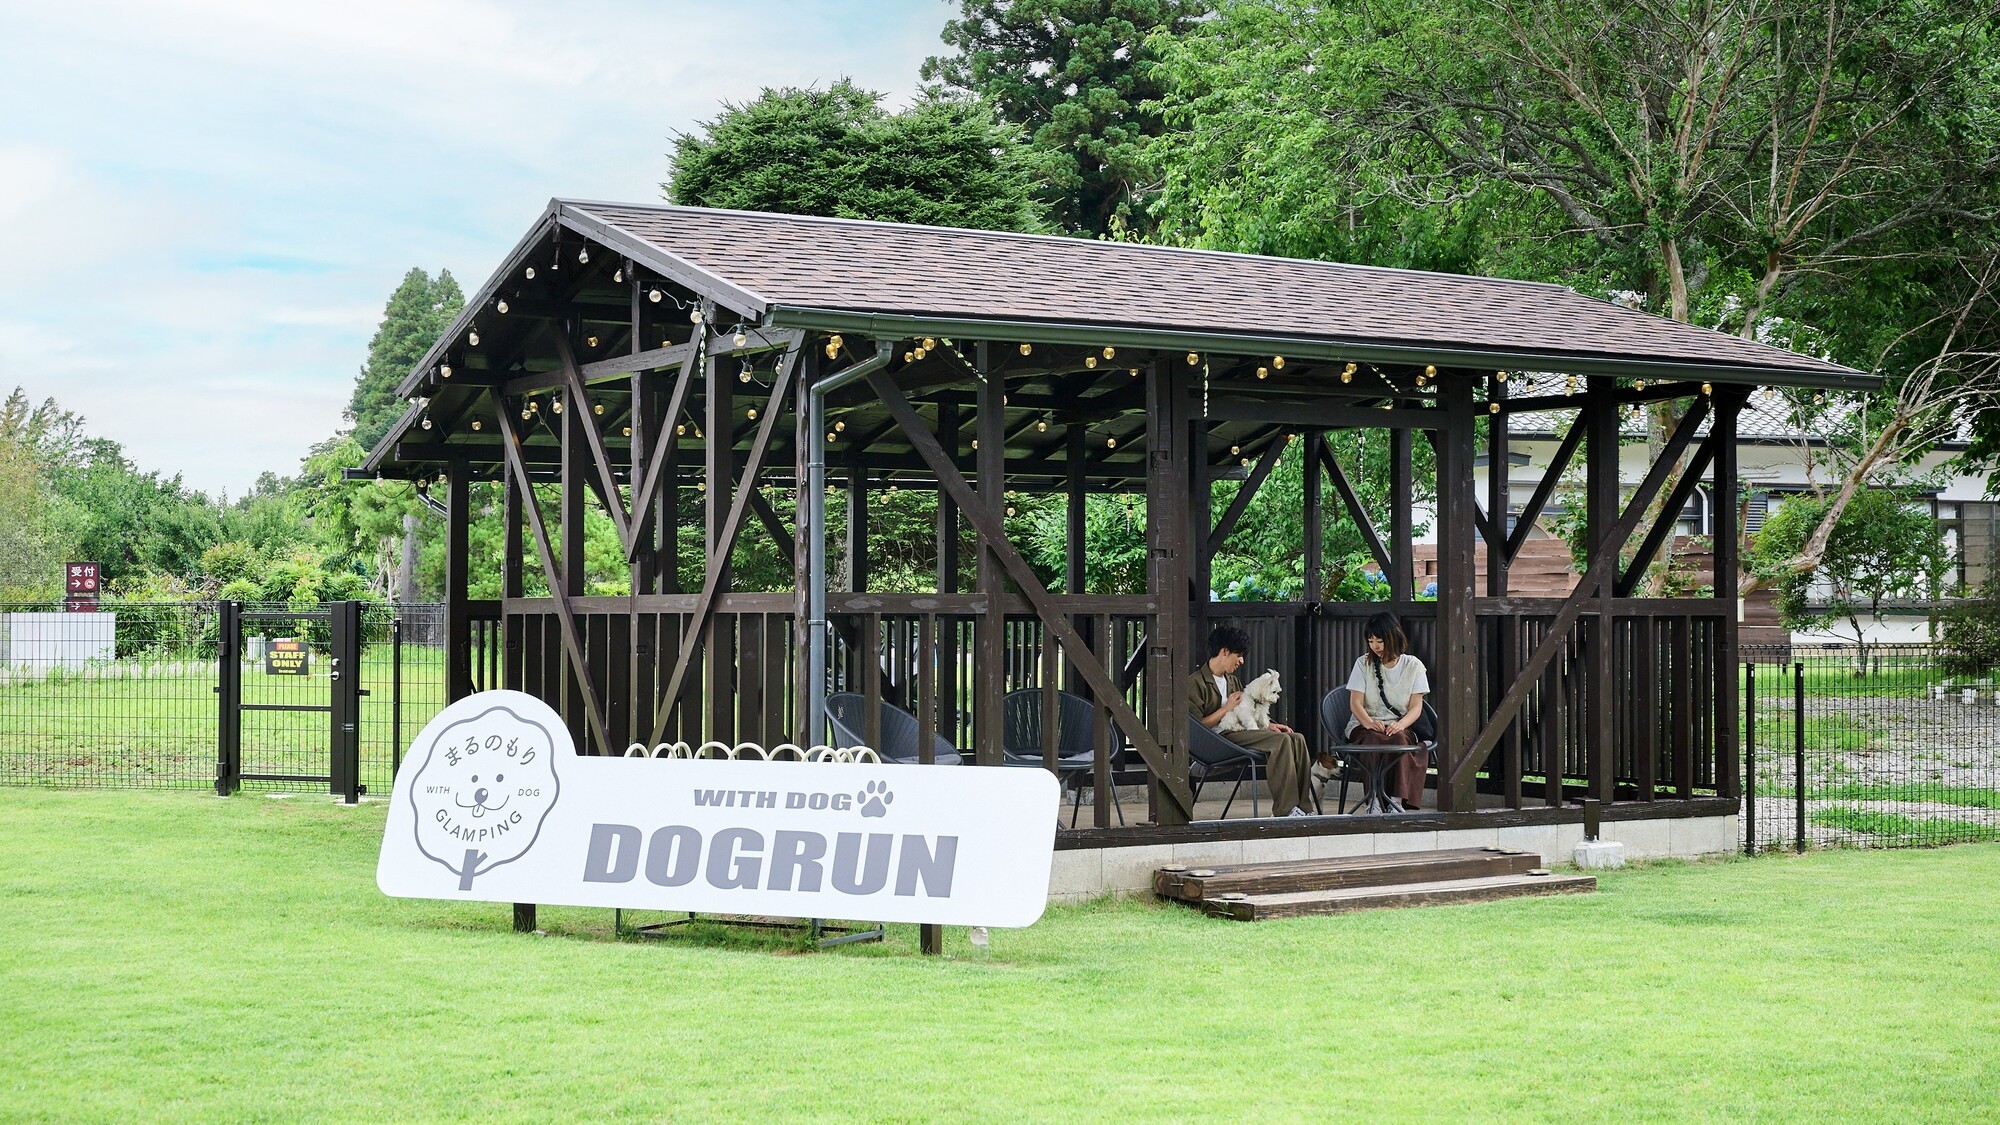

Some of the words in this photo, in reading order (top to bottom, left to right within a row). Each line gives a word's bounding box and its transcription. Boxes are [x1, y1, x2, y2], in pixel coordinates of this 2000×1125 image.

[71, 566, 95, 577] 受付
[269, 651, 306, 659] STAFF
[272, 660, 303, 668] ONLY
[444, 734, 536, 767] まるのもり
[426, 785, 450, 794] WITH
[518, 788, 540, 797] DOG
[693, 789, 777, 808] WITH
[785, 791, 852, 811] DOG
[435, 809, 522, 842] GLAMPING
[583, 823, 959, 898] DOGRUN
